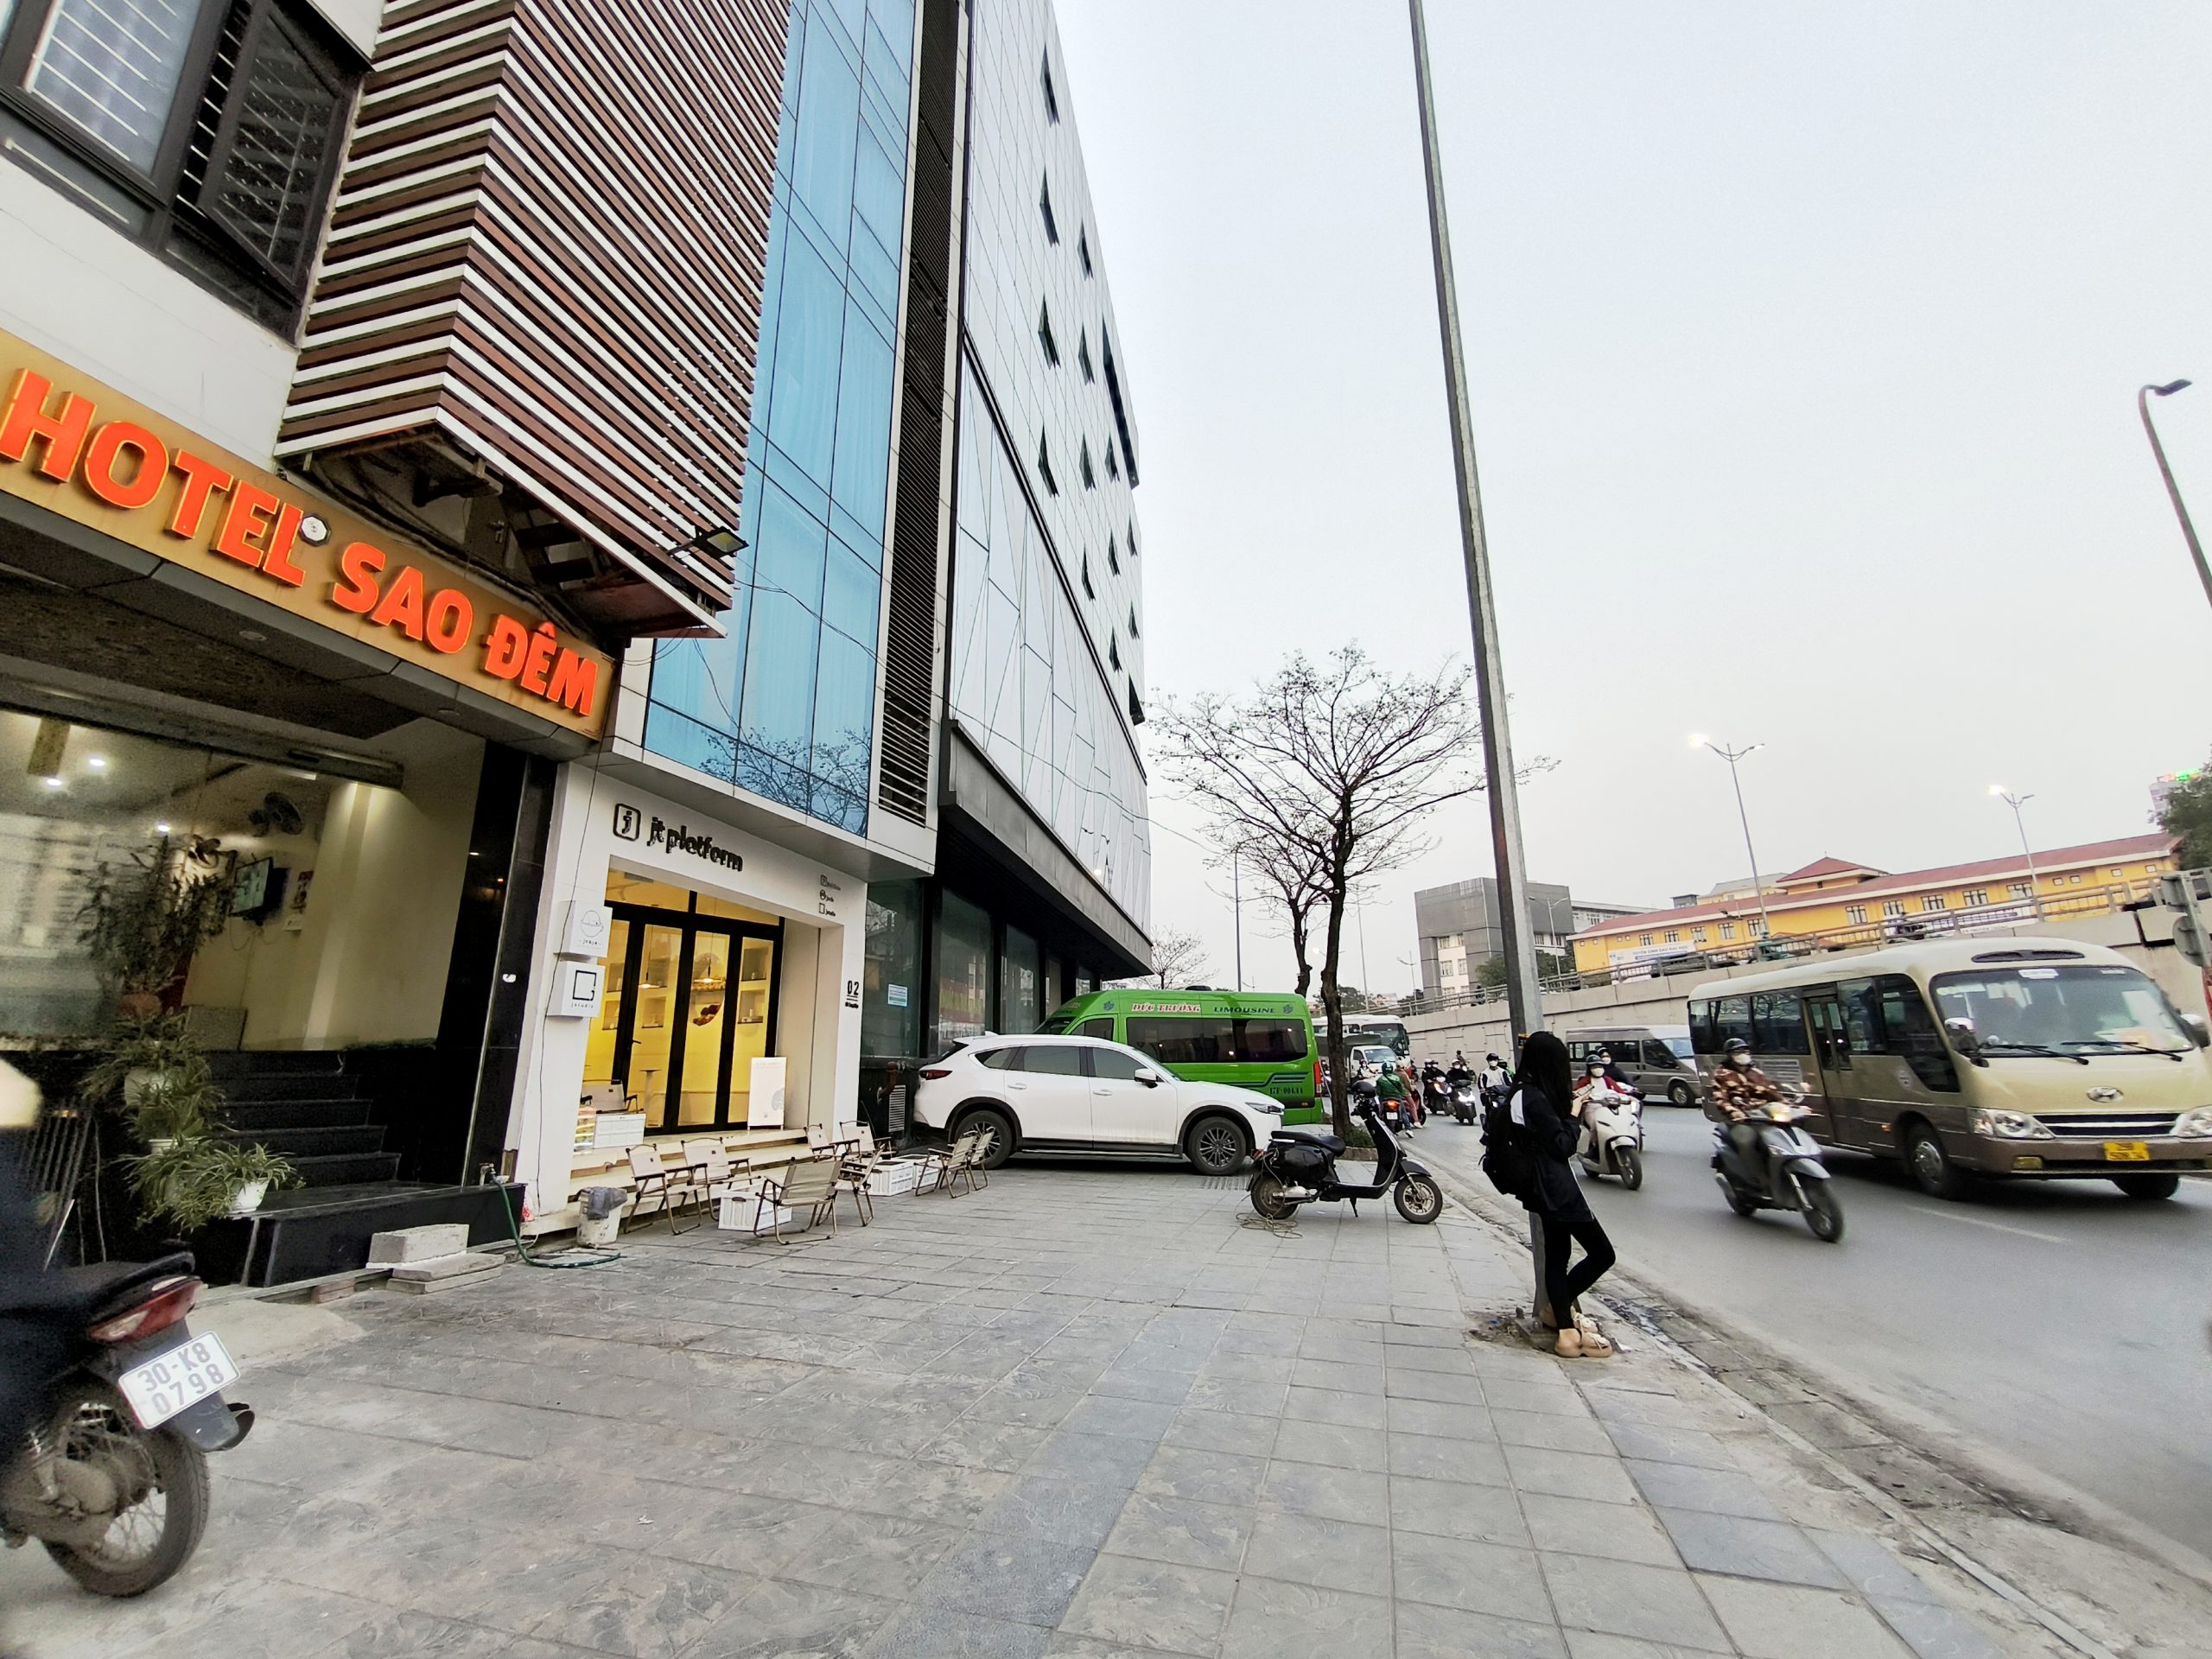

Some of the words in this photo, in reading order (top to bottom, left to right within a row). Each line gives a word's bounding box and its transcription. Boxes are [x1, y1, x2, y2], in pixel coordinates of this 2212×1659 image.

[0, 368, 306, 587] HOTEL
[329, 542, 474, 654] SAO
[480, 614, 599, 716] ĐÊM
[847, 980, 860, 995] 02
[137, 1341, 212, 1392] 30-K8
[151, 1363, 225, 1415] 0798
